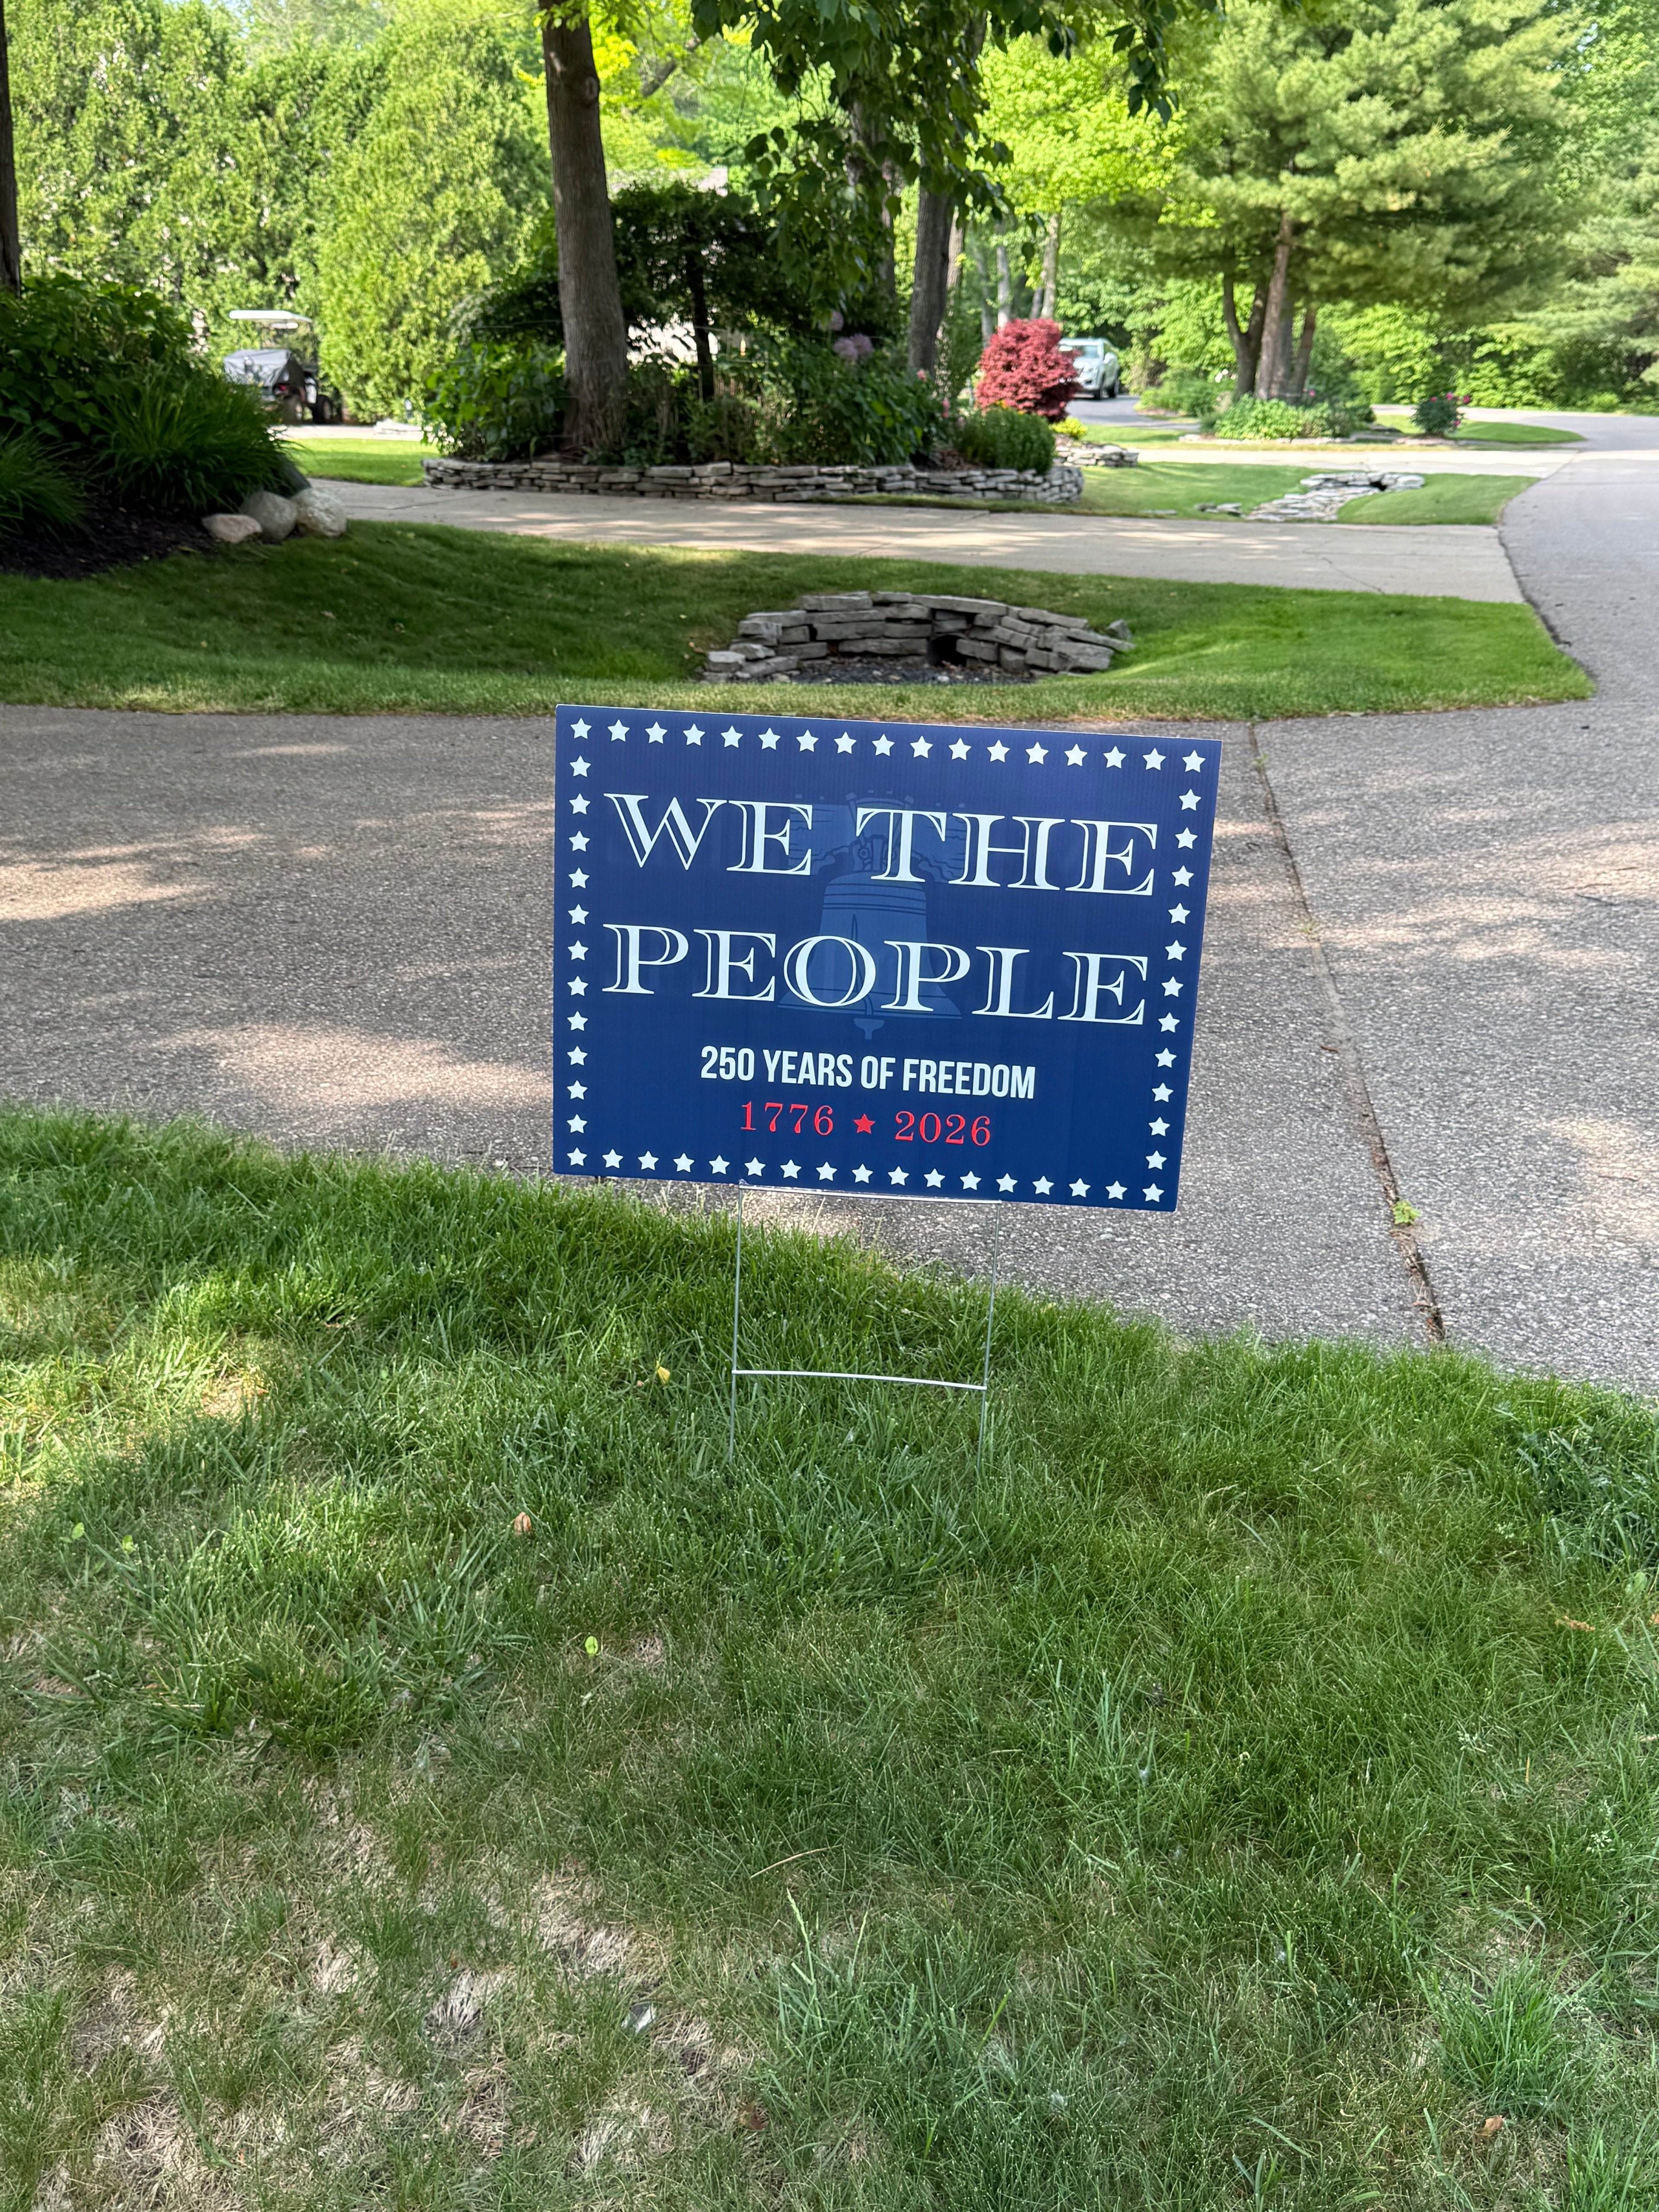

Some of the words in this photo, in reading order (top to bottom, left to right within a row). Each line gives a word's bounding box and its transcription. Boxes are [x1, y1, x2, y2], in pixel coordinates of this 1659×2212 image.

[603, 793, 813, 876] WE
[856, 807, 1158, 896] THE
[602, 924, 1148, 1025] PEOPLE
[701, 1046, 755, 1081] 250
[763, 1049, 853, 1087] YEARS
[861, 1055, 896, 1089] OF
[903, 1058, 1036, 1099] FREEDOM
[741, 1101, 833, 1135] 1776
[895, 1111, 991, 1146] 2026
